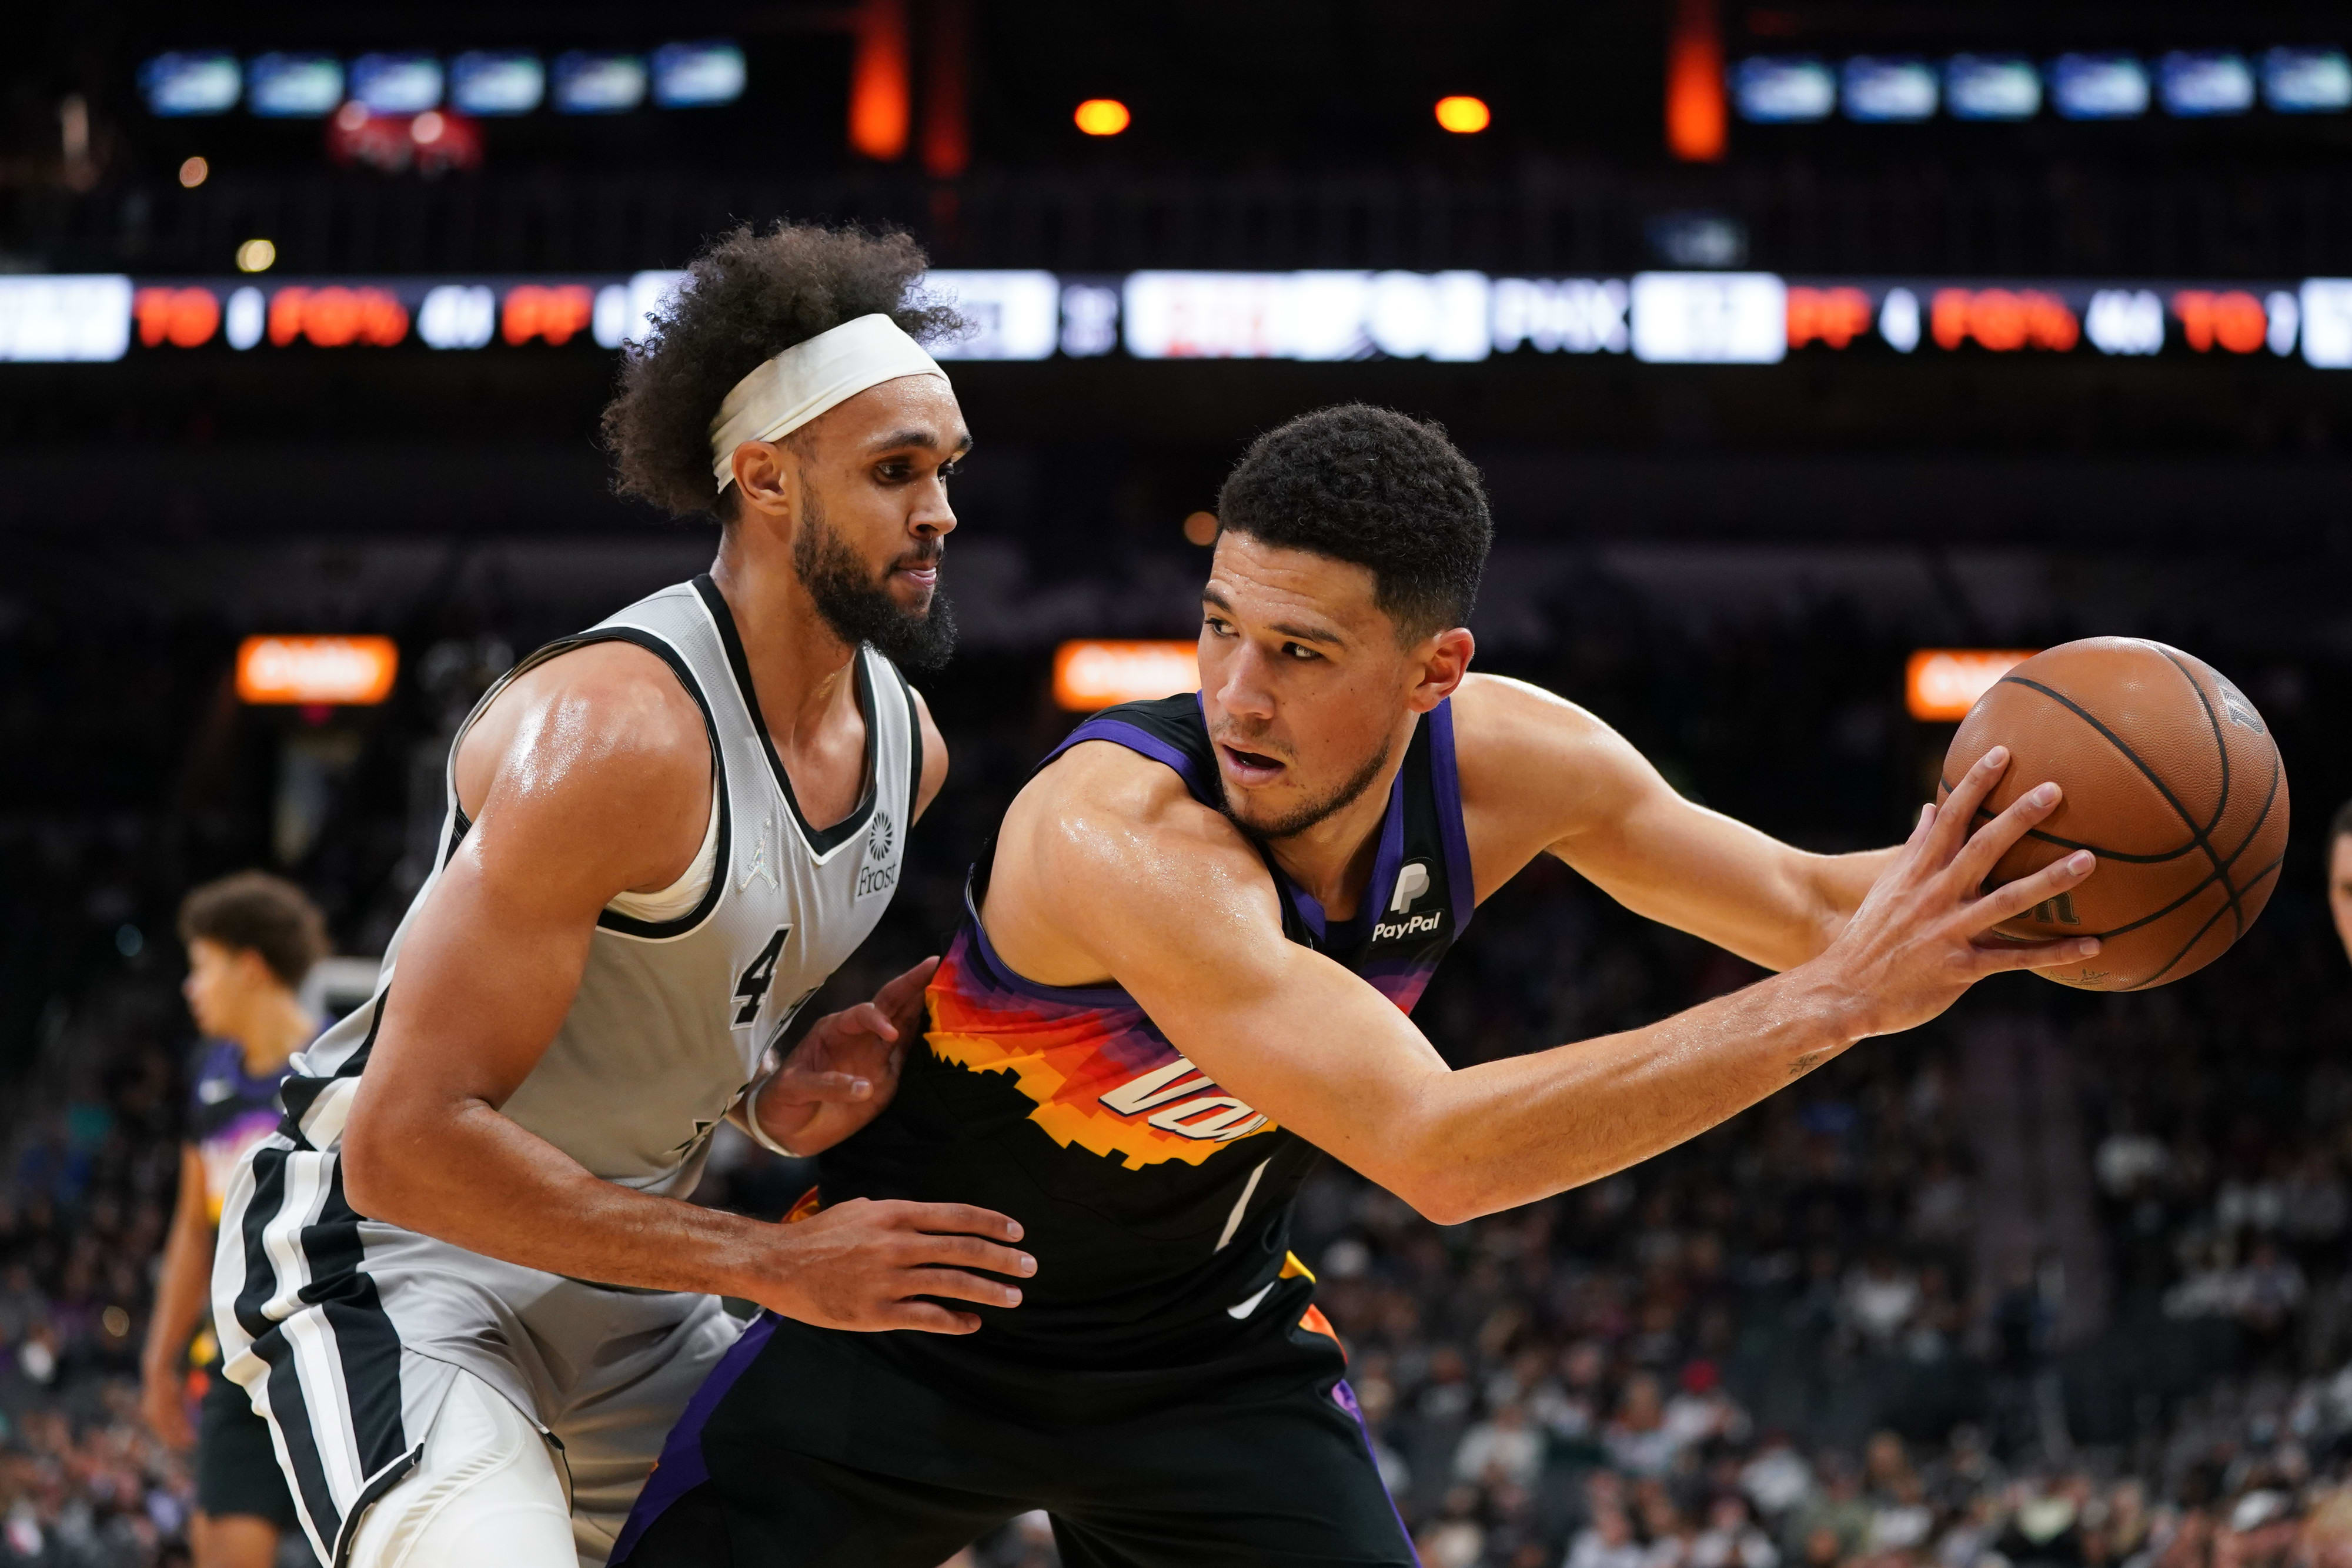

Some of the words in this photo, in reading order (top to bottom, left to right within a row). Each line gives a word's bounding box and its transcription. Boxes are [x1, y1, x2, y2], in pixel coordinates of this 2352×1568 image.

[857, 861, 897, 897] Frost
[1372, 912, 1441, 942] PayPal
[730, 924, 794, 1031] 4
